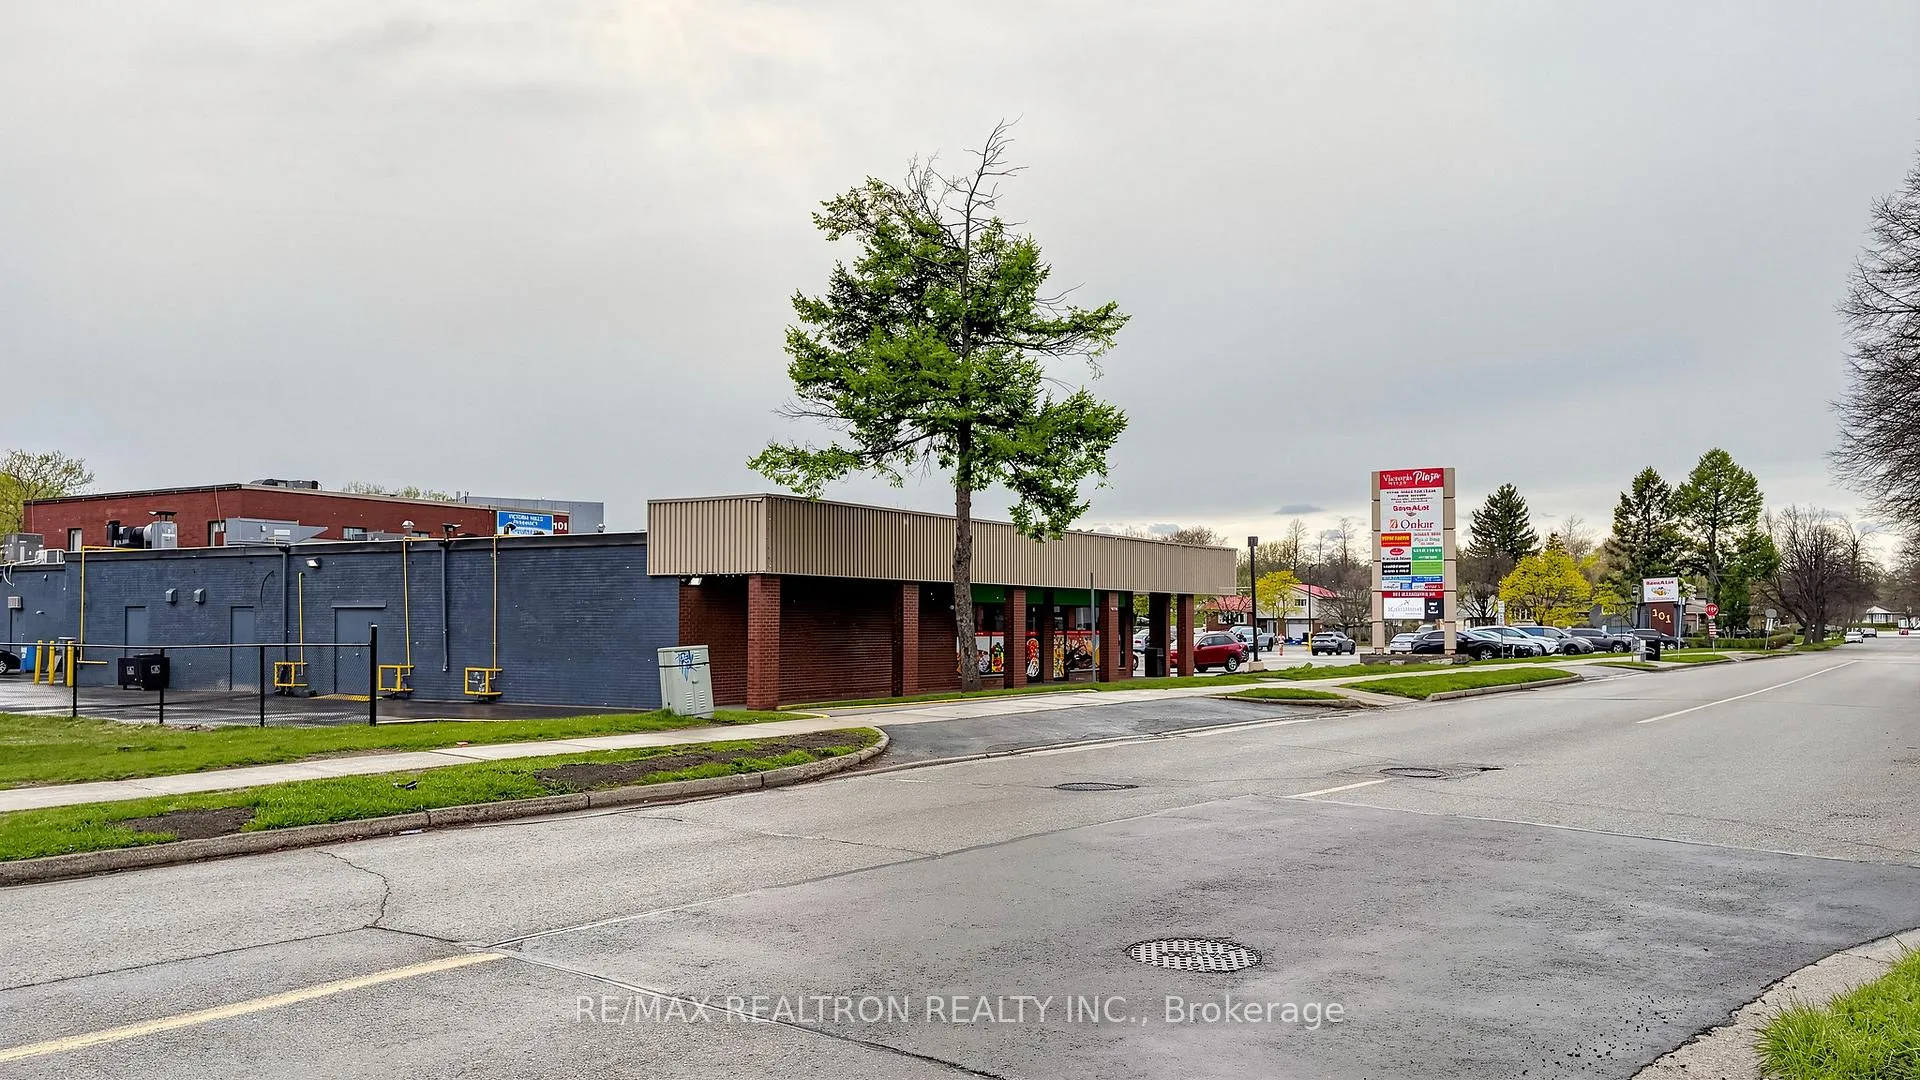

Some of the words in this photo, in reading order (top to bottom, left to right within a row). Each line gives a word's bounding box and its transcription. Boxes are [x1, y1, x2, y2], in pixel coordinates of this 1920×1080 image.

[1412, 470, 1441, 485] Plaza
[553, 522, 568, 531] 101
[1400, 519, 1434, 530] Onkar
[1652, 608, 1672, 624] 101
